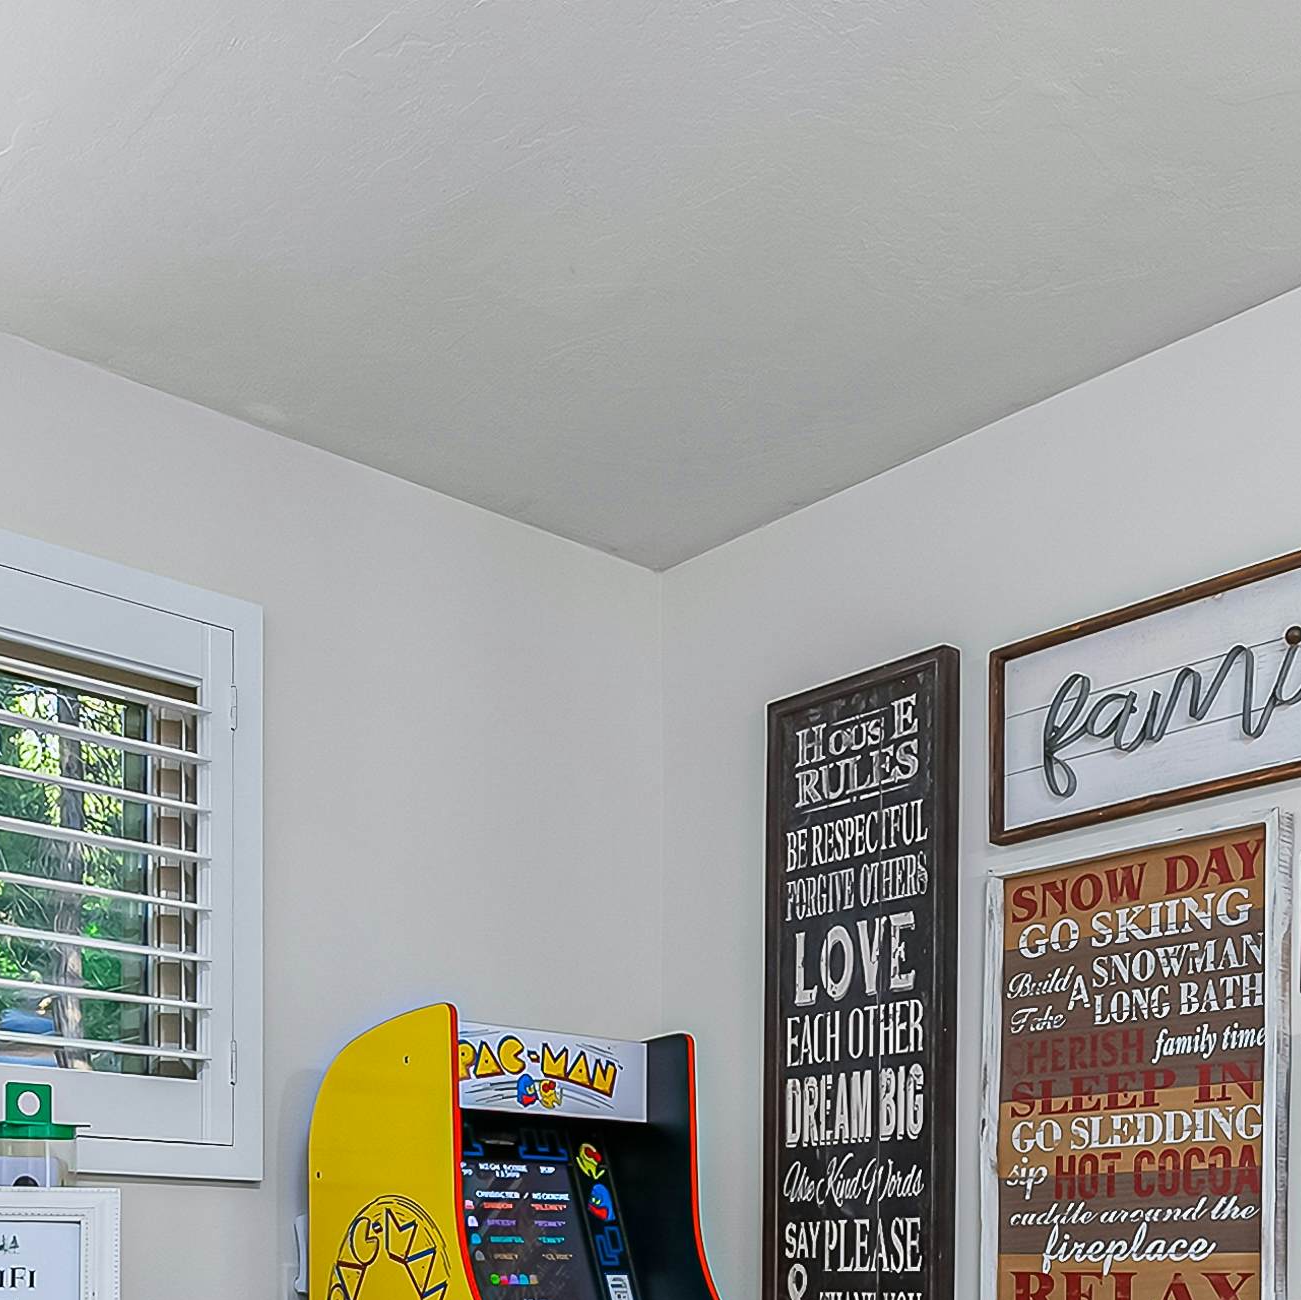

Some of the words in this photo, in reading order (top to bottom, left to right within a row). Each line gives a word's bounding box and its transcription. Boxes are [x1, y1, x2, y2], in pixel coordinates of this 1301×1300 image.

[795, 738, 919, 808] RULES
[786, 829, 808, 873] BE
[811, 799, 928, 864] RESPECTFUL
[785, 868, 855, 922] FORGIVE
[860, 851, 928, 906] OTHERS
[1012, 862, 1147, 924] SNOW
[1165, 838, 1265, 896] DAY
[1018, 918, 1080, 959] GO
[1091, 887, 1253, 948] SKIING
[794, 911, 916, 1007] LOVE
[1006, 965, 1076, 999] Build
[1068, 974, 1090, 1012] A
[1092, 931, 1265, 988] SNOWMAN
[786, 1012, 839, 1067] EACH
[848, 1000, 923, 1059] OTHER
[1010, 1005, 1067, 1034] Take
[1093, 984, 1171, 1026] LONG
[1179, 971, 1265, 1016] BATH
[458, 1035, 617, 1098] PAC-MAN
[1151, 1023, 1217, 1064] family
[1221, 1022, 1265, 1050] time
[785, 1069, 872, 1148] DREAM
[878, 1063, 925, 1141] BIG
[1011, 1067, 1177, 1118] SLEEP
[1194, 1061, 1258, 1103] IN
[1011, 1119, 1062, 1153] GO
[1070, 1104, 1263, 1150] SLEDDING
[783, 1161, 815, 1203] Use
[817, 1153, 863, 1208] Kind
[863, 1162, 924, 1205] Words
[1006, 1156, 1048, 1200] sip
[1054, 1151, 1122, 1200] HOT
[1133, 1144, 1260, 1198] COCOA
[1009, 1202, 1098, 1226] cuddle
[1100, 1197, 1208, 1224] around
[1210, 1195, 1260, 1221] the
[785, 1220, 821, 1259] SAY
[823, 1217, 922, 1273] PLEASE
[1042, 1220, 1216, 1276] fireplace
